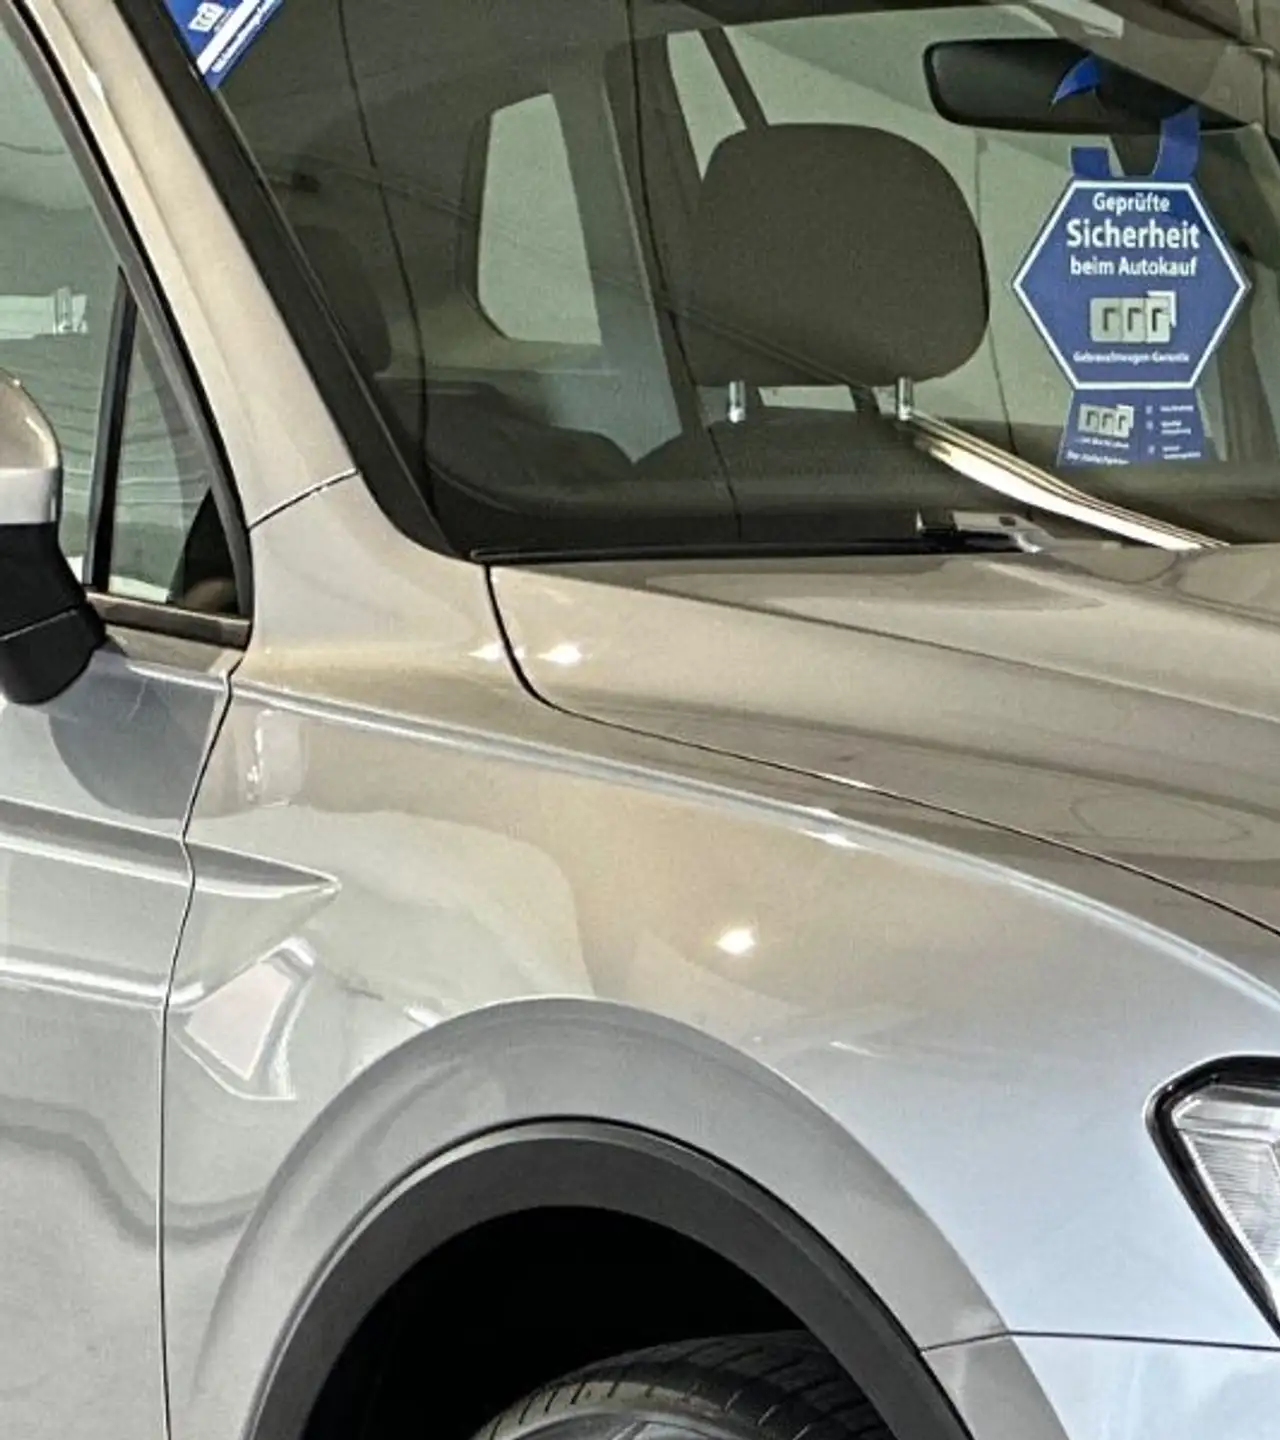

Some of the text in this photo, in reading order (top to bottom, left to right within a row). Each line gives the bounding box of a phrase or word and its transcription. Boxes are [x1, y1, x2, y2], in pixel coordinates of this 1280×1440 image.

[1092, 192, 1171, 216] Geprüfte
[1066, 218, 1200, 249] Sicherheit
[1070, 254, 1198, 276] beim Autokauf
